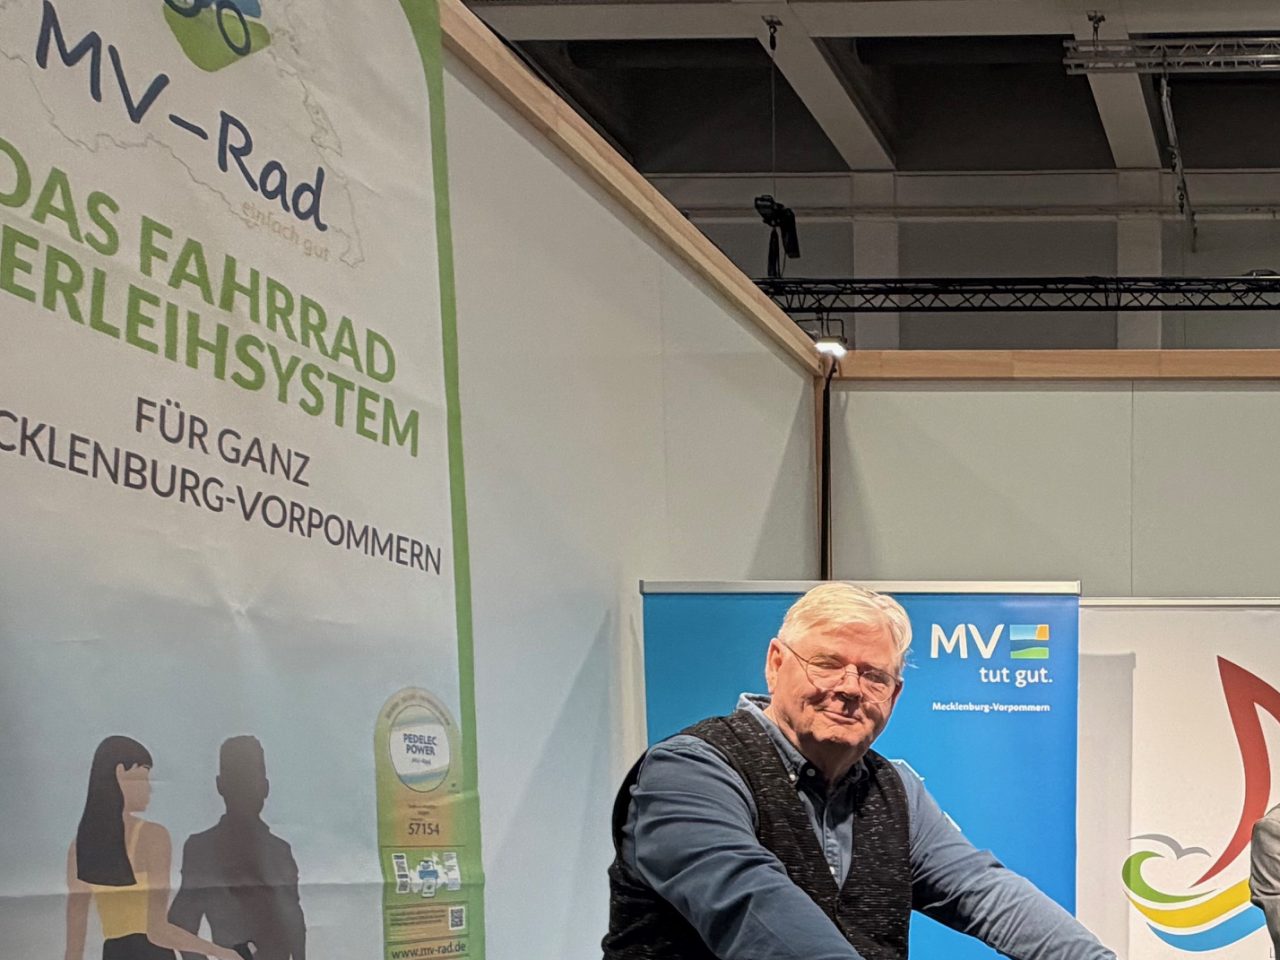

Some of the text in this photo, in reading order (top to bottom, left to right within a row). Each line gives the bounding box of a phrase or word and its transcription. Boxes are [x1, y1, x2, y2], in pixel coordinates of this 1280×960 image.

[37, 0, 328, 232] MV-Rad
[241, 201, 331, 263] einfach gut
[0, 137, 397, 385] DAS FAHRRAD
[136, 397, 312, 487] FÜR GANZ
[930, 623, 1005, 660] MV
[979, 667, 1053, 688] tut gut.
[931, 701, 1051, 713] Mecklenburg-Vorpommern
[402, 733, 438, 747] PEDELEC
[405, 743, 436, 756] POWER
[408, 822, 440, 836] 57154
[391, 942, 467, 960] www.mv-rad.de
